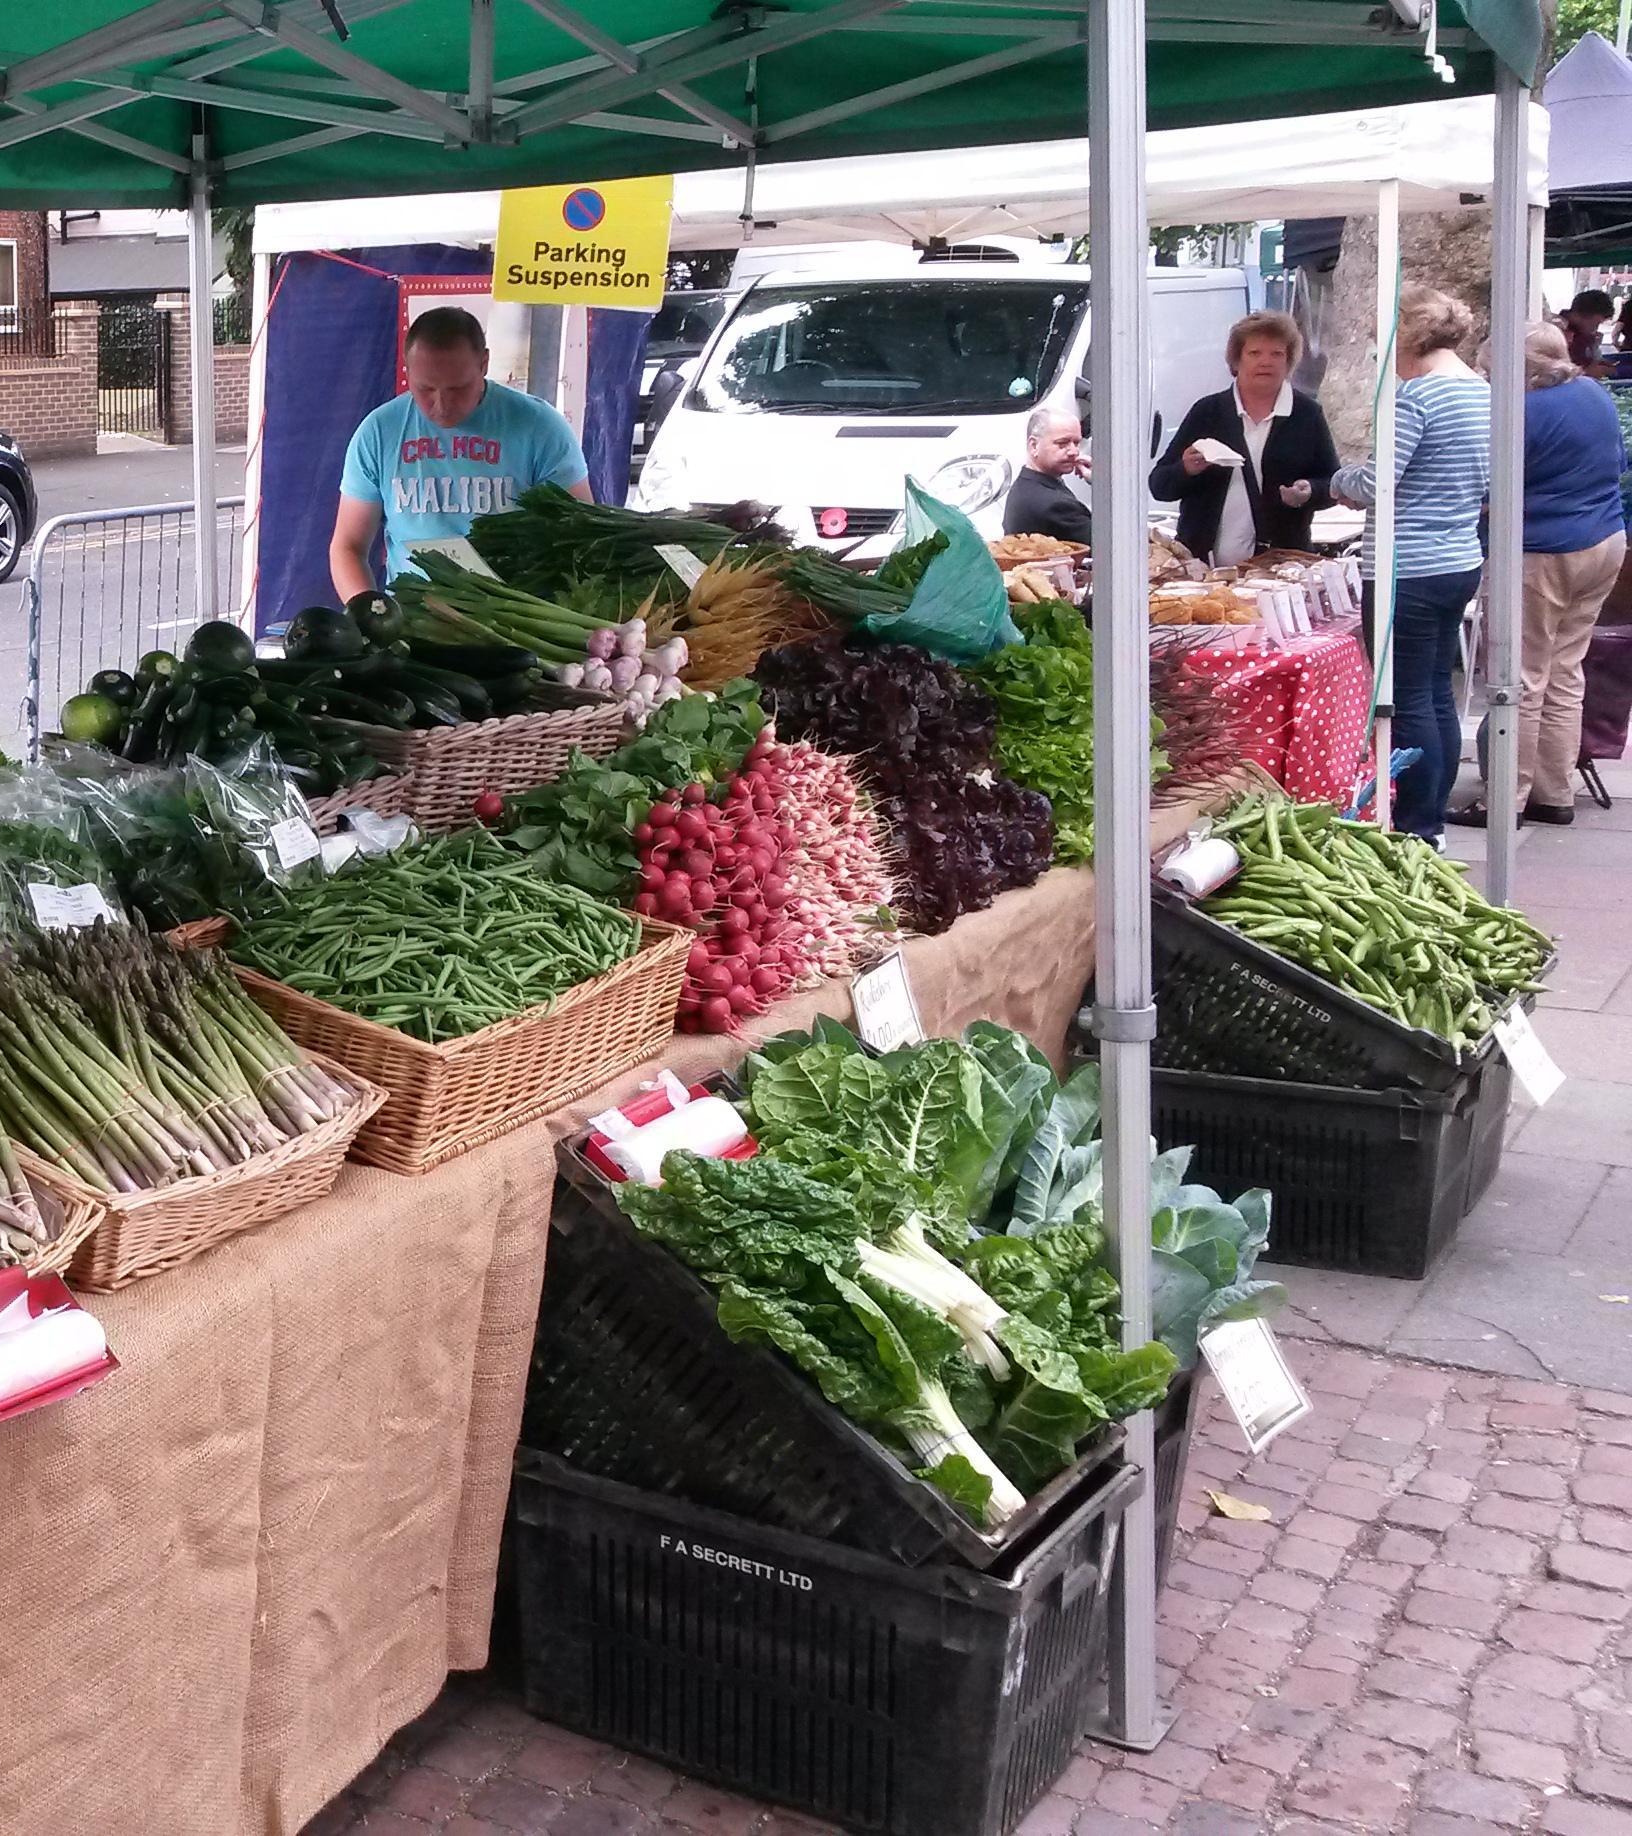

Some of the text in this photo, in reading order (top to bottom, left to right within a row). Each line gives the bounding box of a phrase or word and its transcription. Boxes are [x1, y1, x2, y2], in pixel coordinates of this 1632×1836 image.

[533, 241, 627, 267] Parking
[506, 264, 650, 289] Suspension
[391, 476, 518, 515] MALIBU
[1230, 962, 1241, 971] F
[1239, 969, 1250, 979] A
[1306, 1005, 1332, 1023] LTD
[660, 1534, 813, 1591] F A SECRETT LTD
